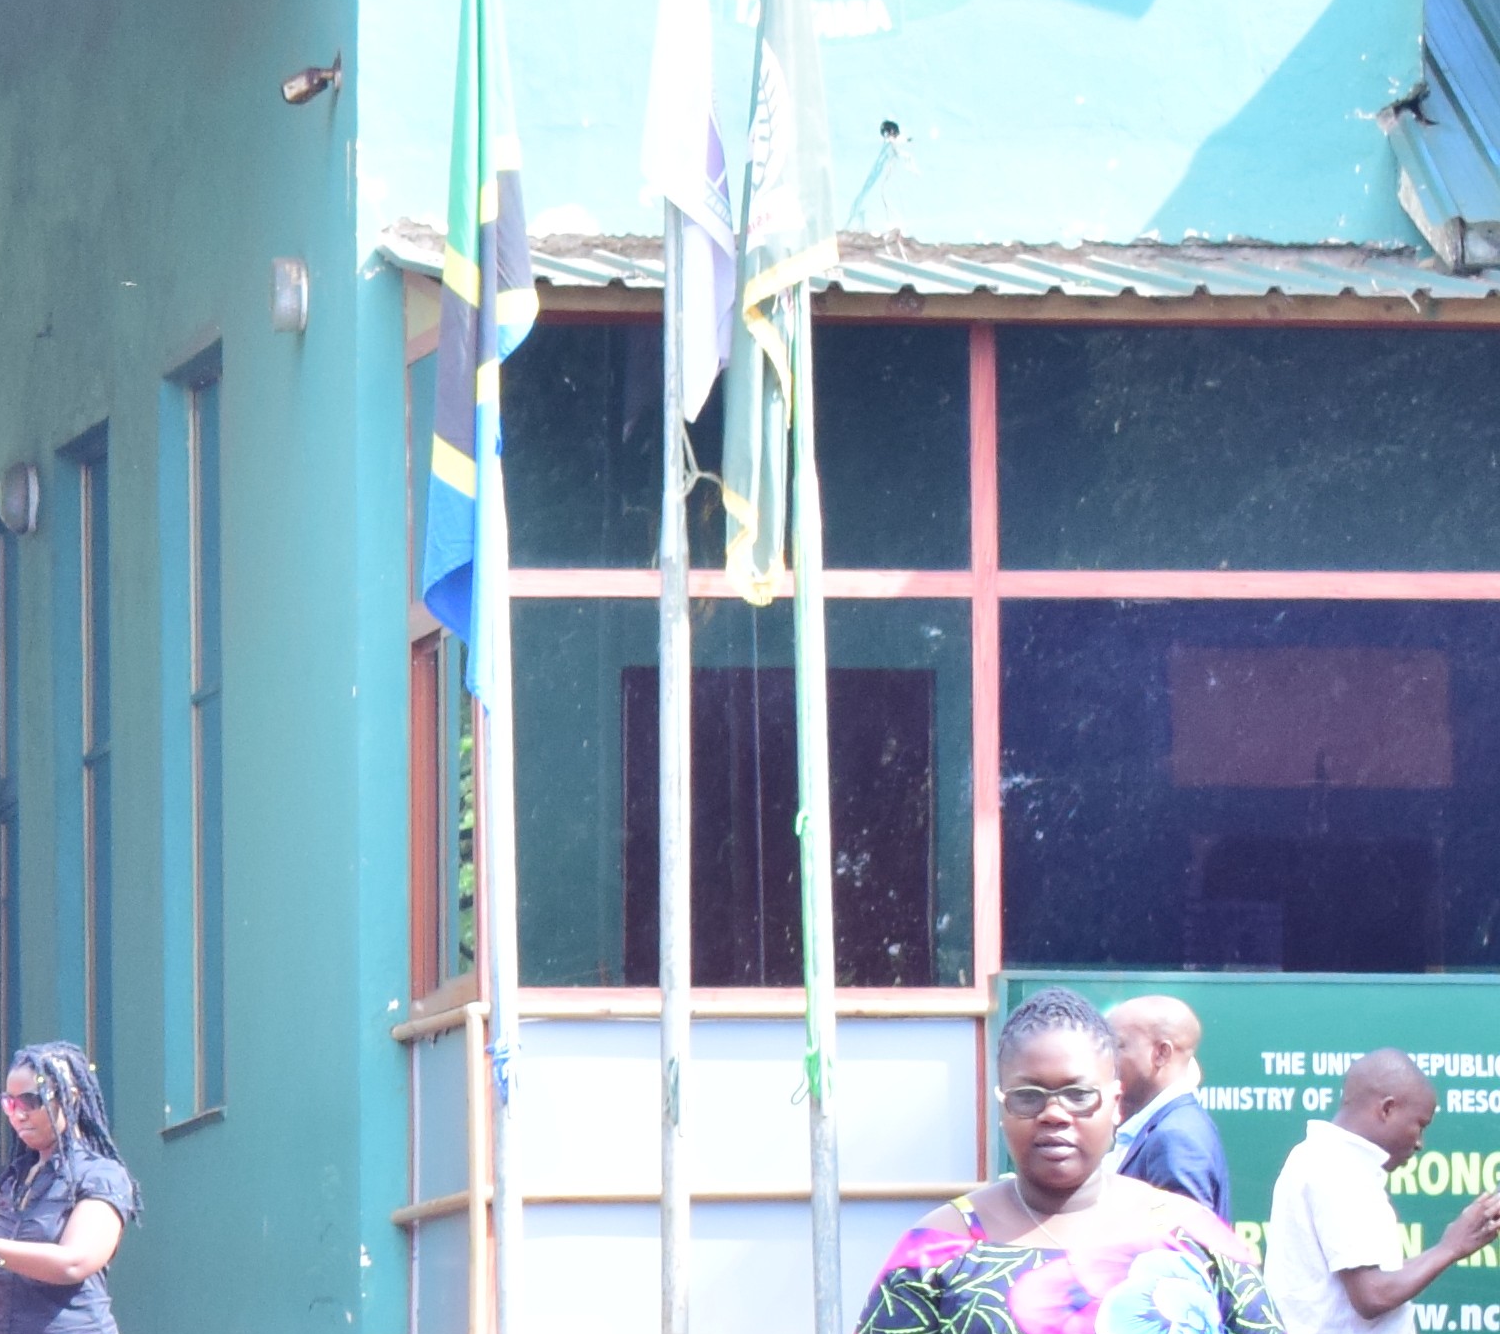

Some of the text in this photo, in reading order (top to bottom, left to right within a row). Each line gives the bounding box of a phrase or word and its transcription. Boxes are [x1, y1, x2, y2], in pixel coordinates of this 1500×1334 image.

[1261, 1051, 1500, 1078] THE UNI EPUBLI
[1302, 1087, 1333, 1111] OF
